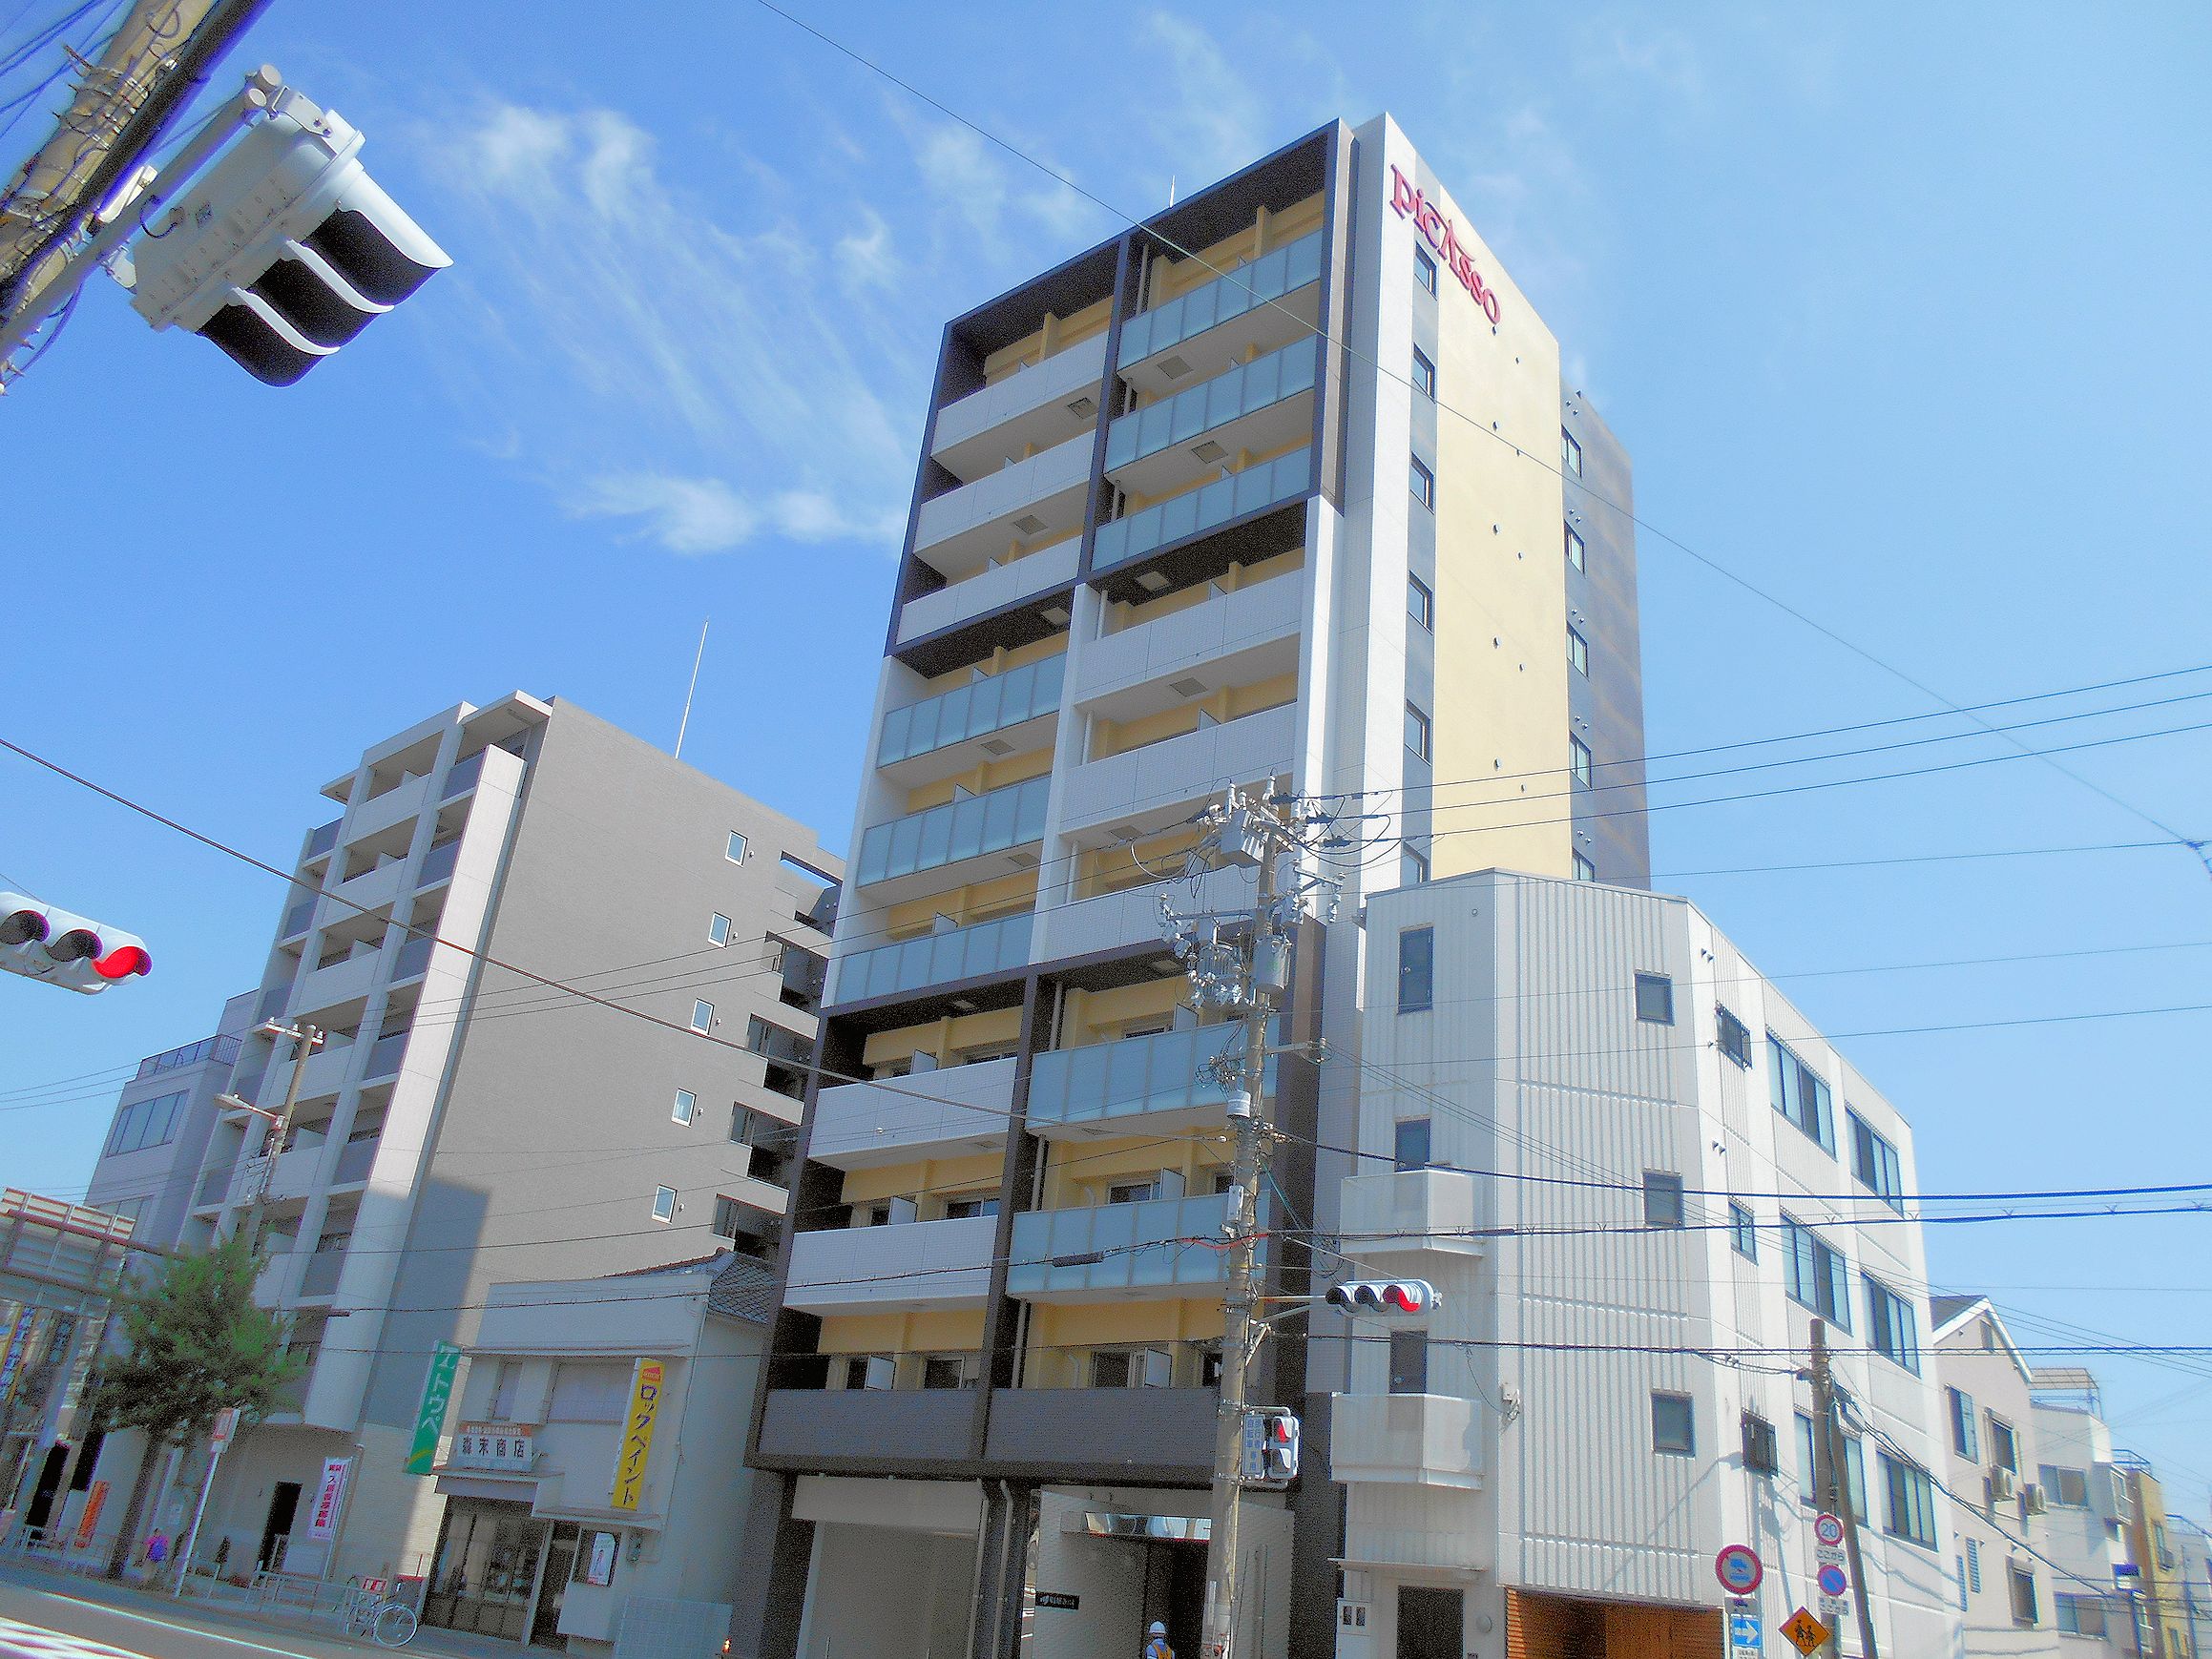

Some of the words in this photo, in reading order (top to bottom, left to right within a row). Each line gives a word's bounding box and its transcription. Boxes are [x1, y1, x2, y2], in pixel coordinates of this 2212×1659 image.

[623, 1383, 657, 1505] ロックペイント
[1822, 1524, 1837, 1537] 20
